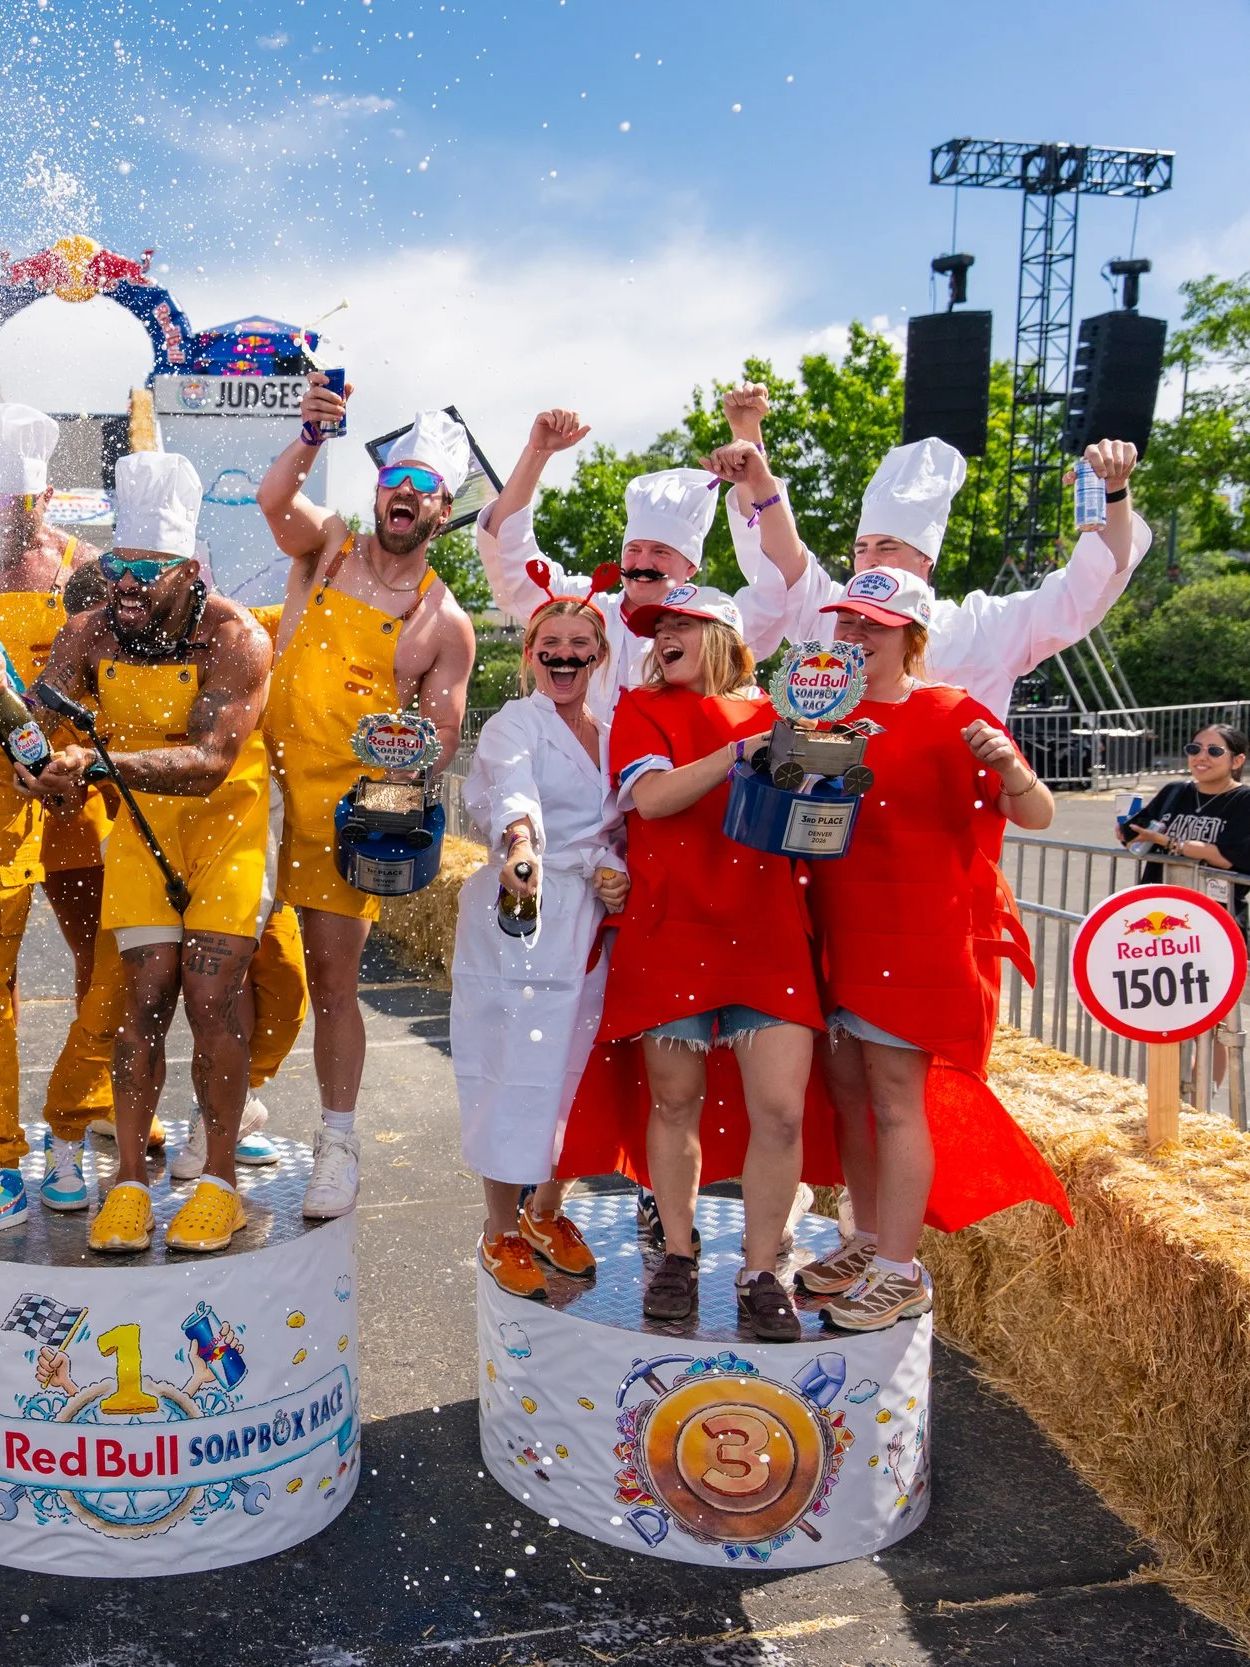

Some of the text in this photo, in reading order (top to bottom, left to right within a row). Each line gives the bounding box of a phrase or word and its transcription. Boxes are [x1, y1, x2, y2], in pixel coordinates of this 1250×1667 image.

[216, 382, 302, 409] JUDGES
[790, 672, 848, 688] Red Bull
[795, 687, 839, 699] SOAPBOX
[803, 700, 825, 710] RACE
[368, 735, 423, 749] Red Bull
[375, 747, 416, 756] SOAPBOX
[801, 815, 844, 825] 3RD PLACE
[1117, 935, 1201, 960] Red Bull
[97, 1323, 159, 1415] 1
[5, 1382, 343, 1478] Red Bull SOAPBOX RACE
[701, 1413, 770, 1498] 3
